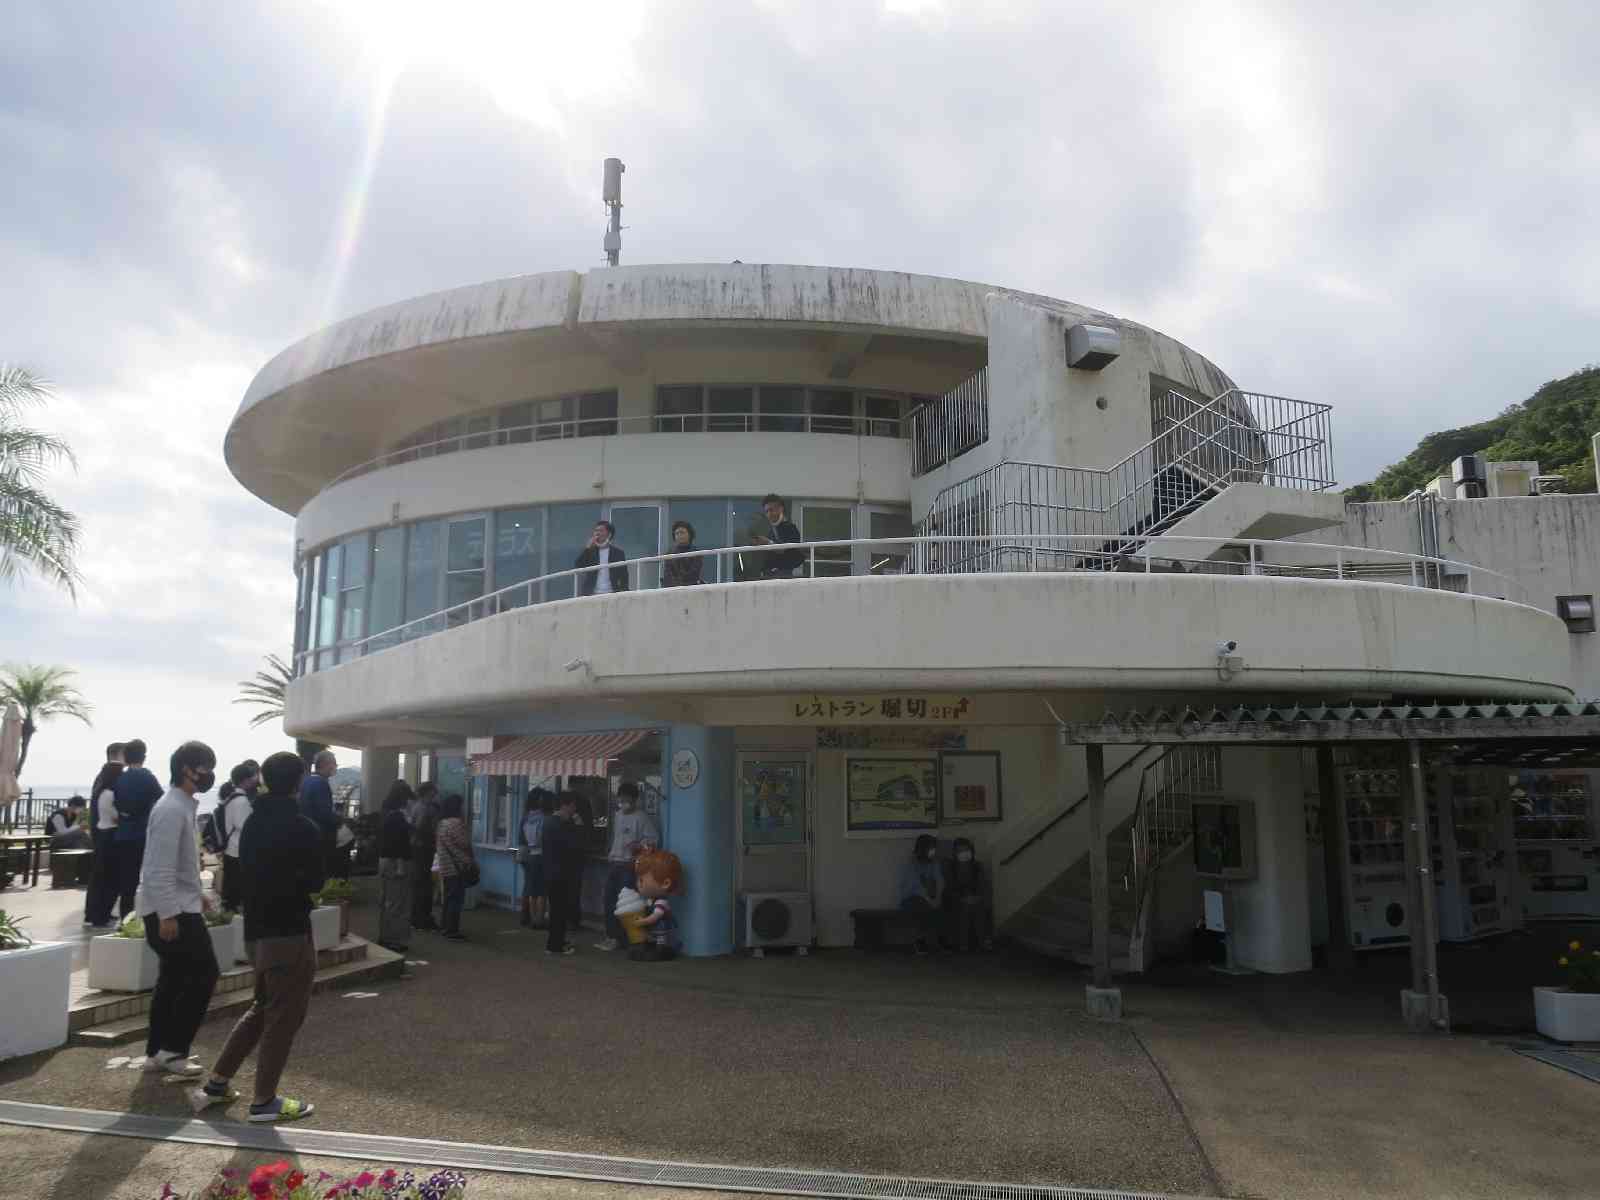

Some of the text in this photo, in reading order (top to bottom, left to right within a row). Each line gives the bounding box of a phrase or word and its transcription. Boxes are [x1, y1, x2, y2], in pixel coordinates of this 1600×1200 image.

[795, 697, 952, 719] レストラン 堀切 2F
